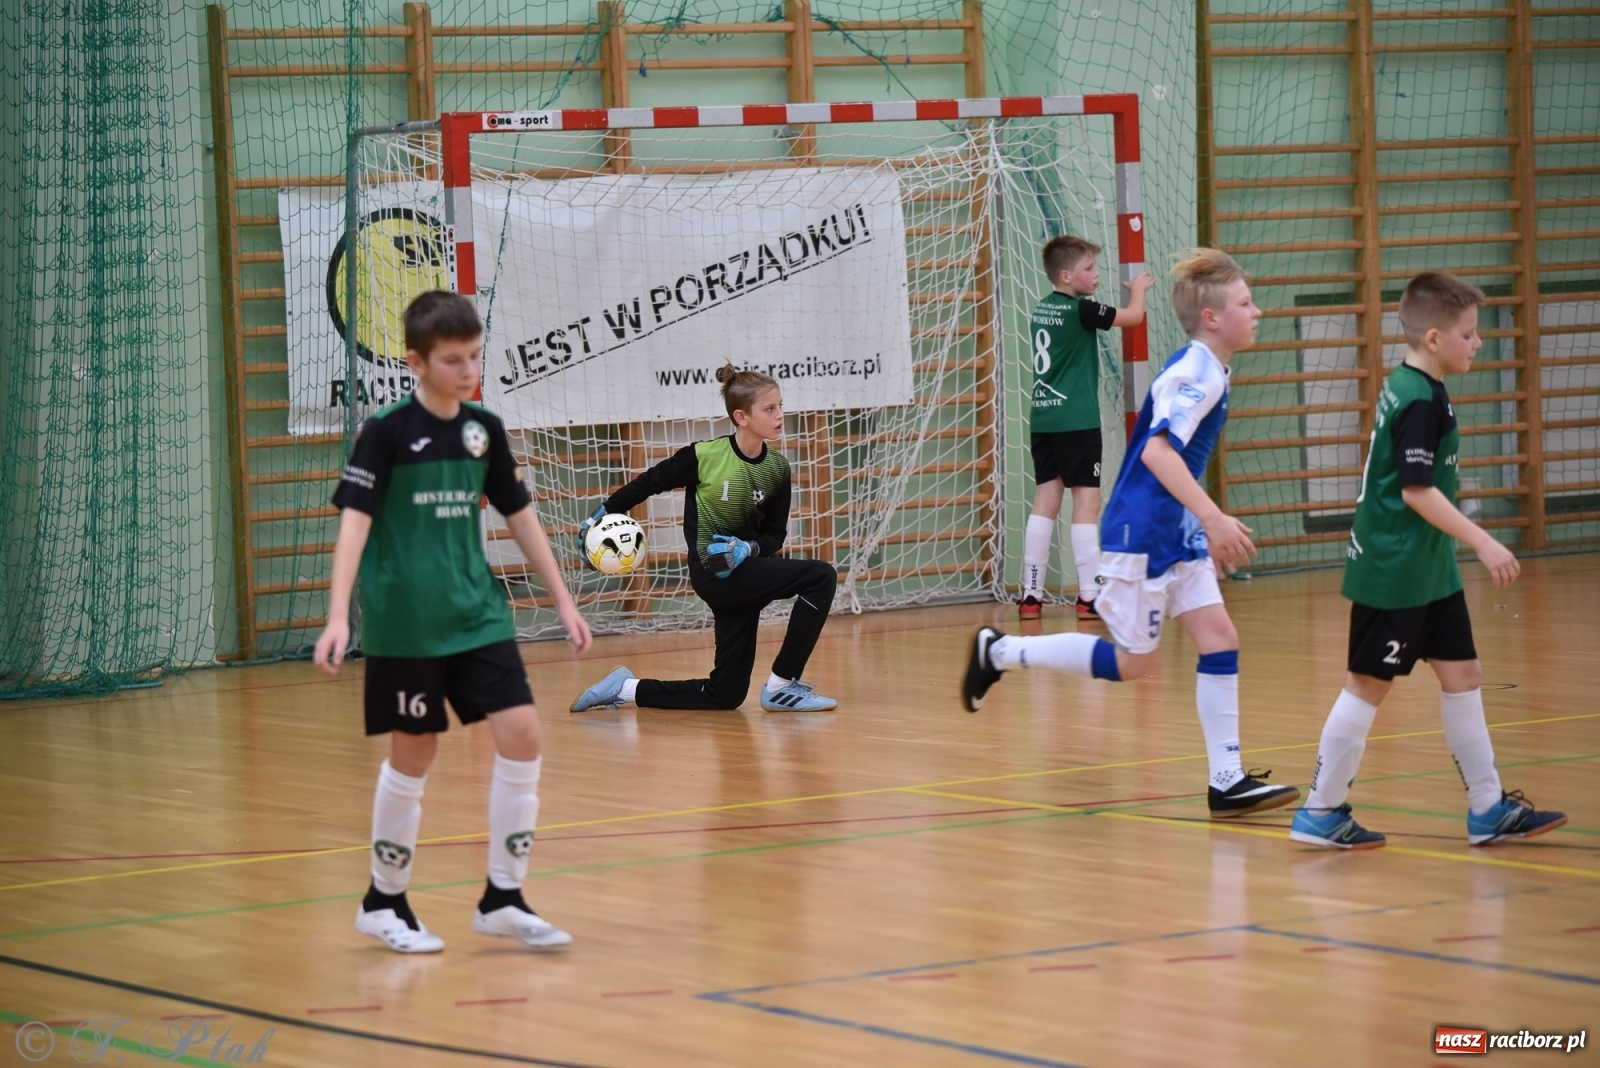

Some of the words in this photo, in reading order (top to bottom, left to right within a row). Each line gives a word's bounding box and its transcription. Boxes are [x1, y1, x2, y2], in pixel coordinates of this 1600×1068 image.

[499, 316, 593, 386] JEST
[603, 296, 643, 342] W
[649, 203, 872, 324] PORZĄDKU!
[1033, 329, 1051, 375] 8
[1093, 462, 1101, 477] 8
[720, 480, 729, 501] 1
[1148, 609, 1161, 639] 5
[396, 690, 428, 718] 16
